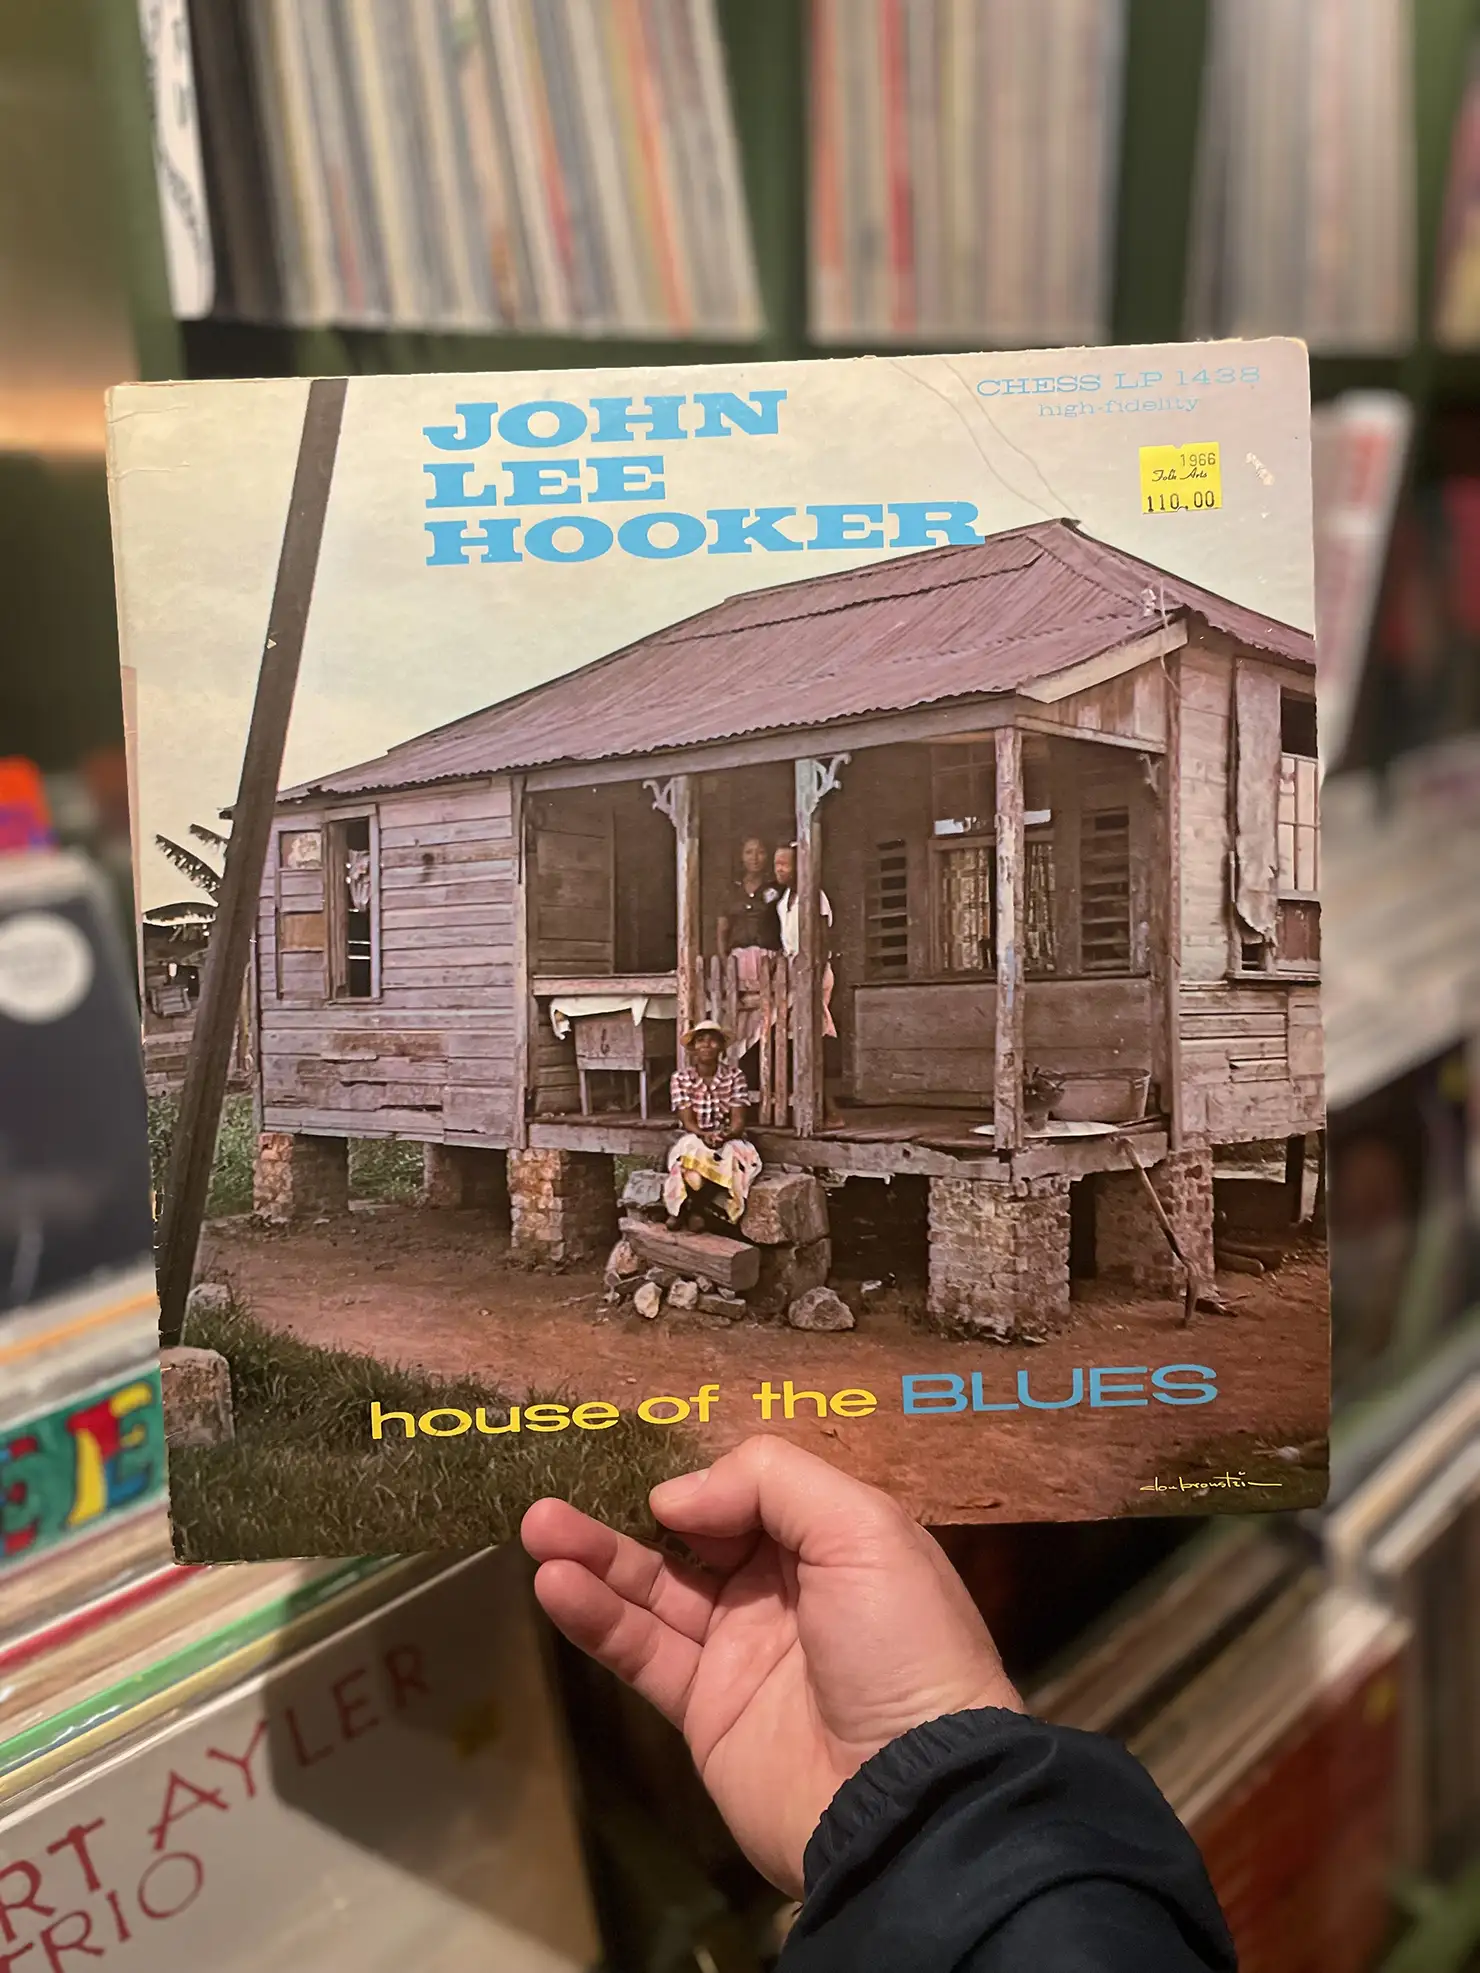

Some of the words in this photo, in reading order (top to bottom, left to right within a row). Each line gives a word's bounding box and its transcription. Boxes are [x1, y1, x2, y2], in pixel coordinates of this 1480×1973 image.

[976, 374, 1100, 397] CHESS
[1114, 371, 1163, 390] LP
[1176, 366, 1261, 387] 1438
[422, 390, 787, 450] JOHN
[1038, 396, 1199, 418] high-fidelity
[1180, 452, 1216, 467] 1966
[1180, 467, 1207, 480] Arts
[423, 455, 666, 508] LEE
[1147, 490, 1215, 512] 110.00
[424, 501, 985, 566] HOOKER
[371, 1401, 620, 1440] house
[637, 1384, 720, 1424] of
[753, 1380, 877, 1420] the
[902, 1364, 1218, 1415] BLUES
[148, 1644, 430, 1851] AYLER
